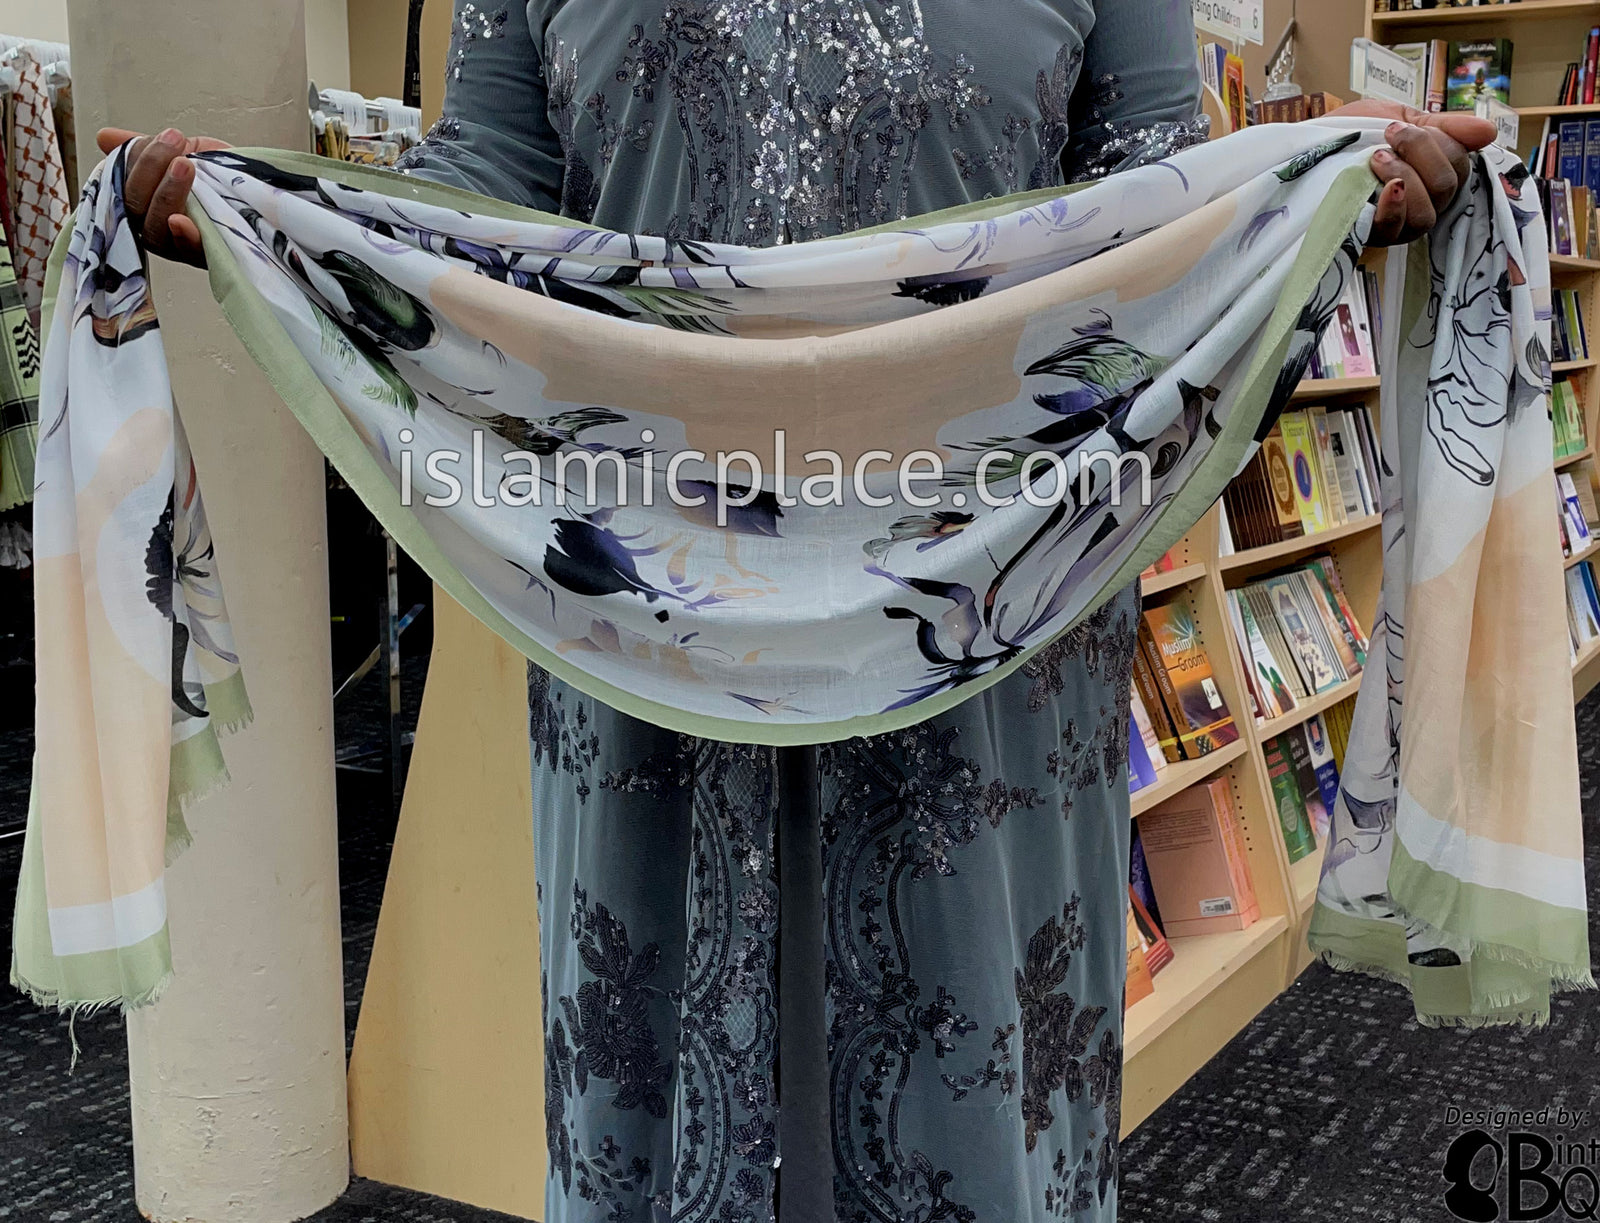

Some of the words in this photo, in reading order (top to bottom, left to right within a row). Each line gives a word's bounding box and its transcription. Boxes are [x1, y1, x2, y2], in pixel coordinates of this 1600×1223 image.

[1213, 3, 1241, 28] Children
[1253, 8, 1259, 29] 6
[1368, 61, 1388, 83] Women
[1388, 69, 1408, 93] Related
[1161, 636, 1193, 657] Muslim
[1147, 641, 1161, 668] Muslim
[1158, 668, 1172, 695] Groom
[1177, 653, 1206, 672] Groom
[1141, 673, 1154, 699] Groom
